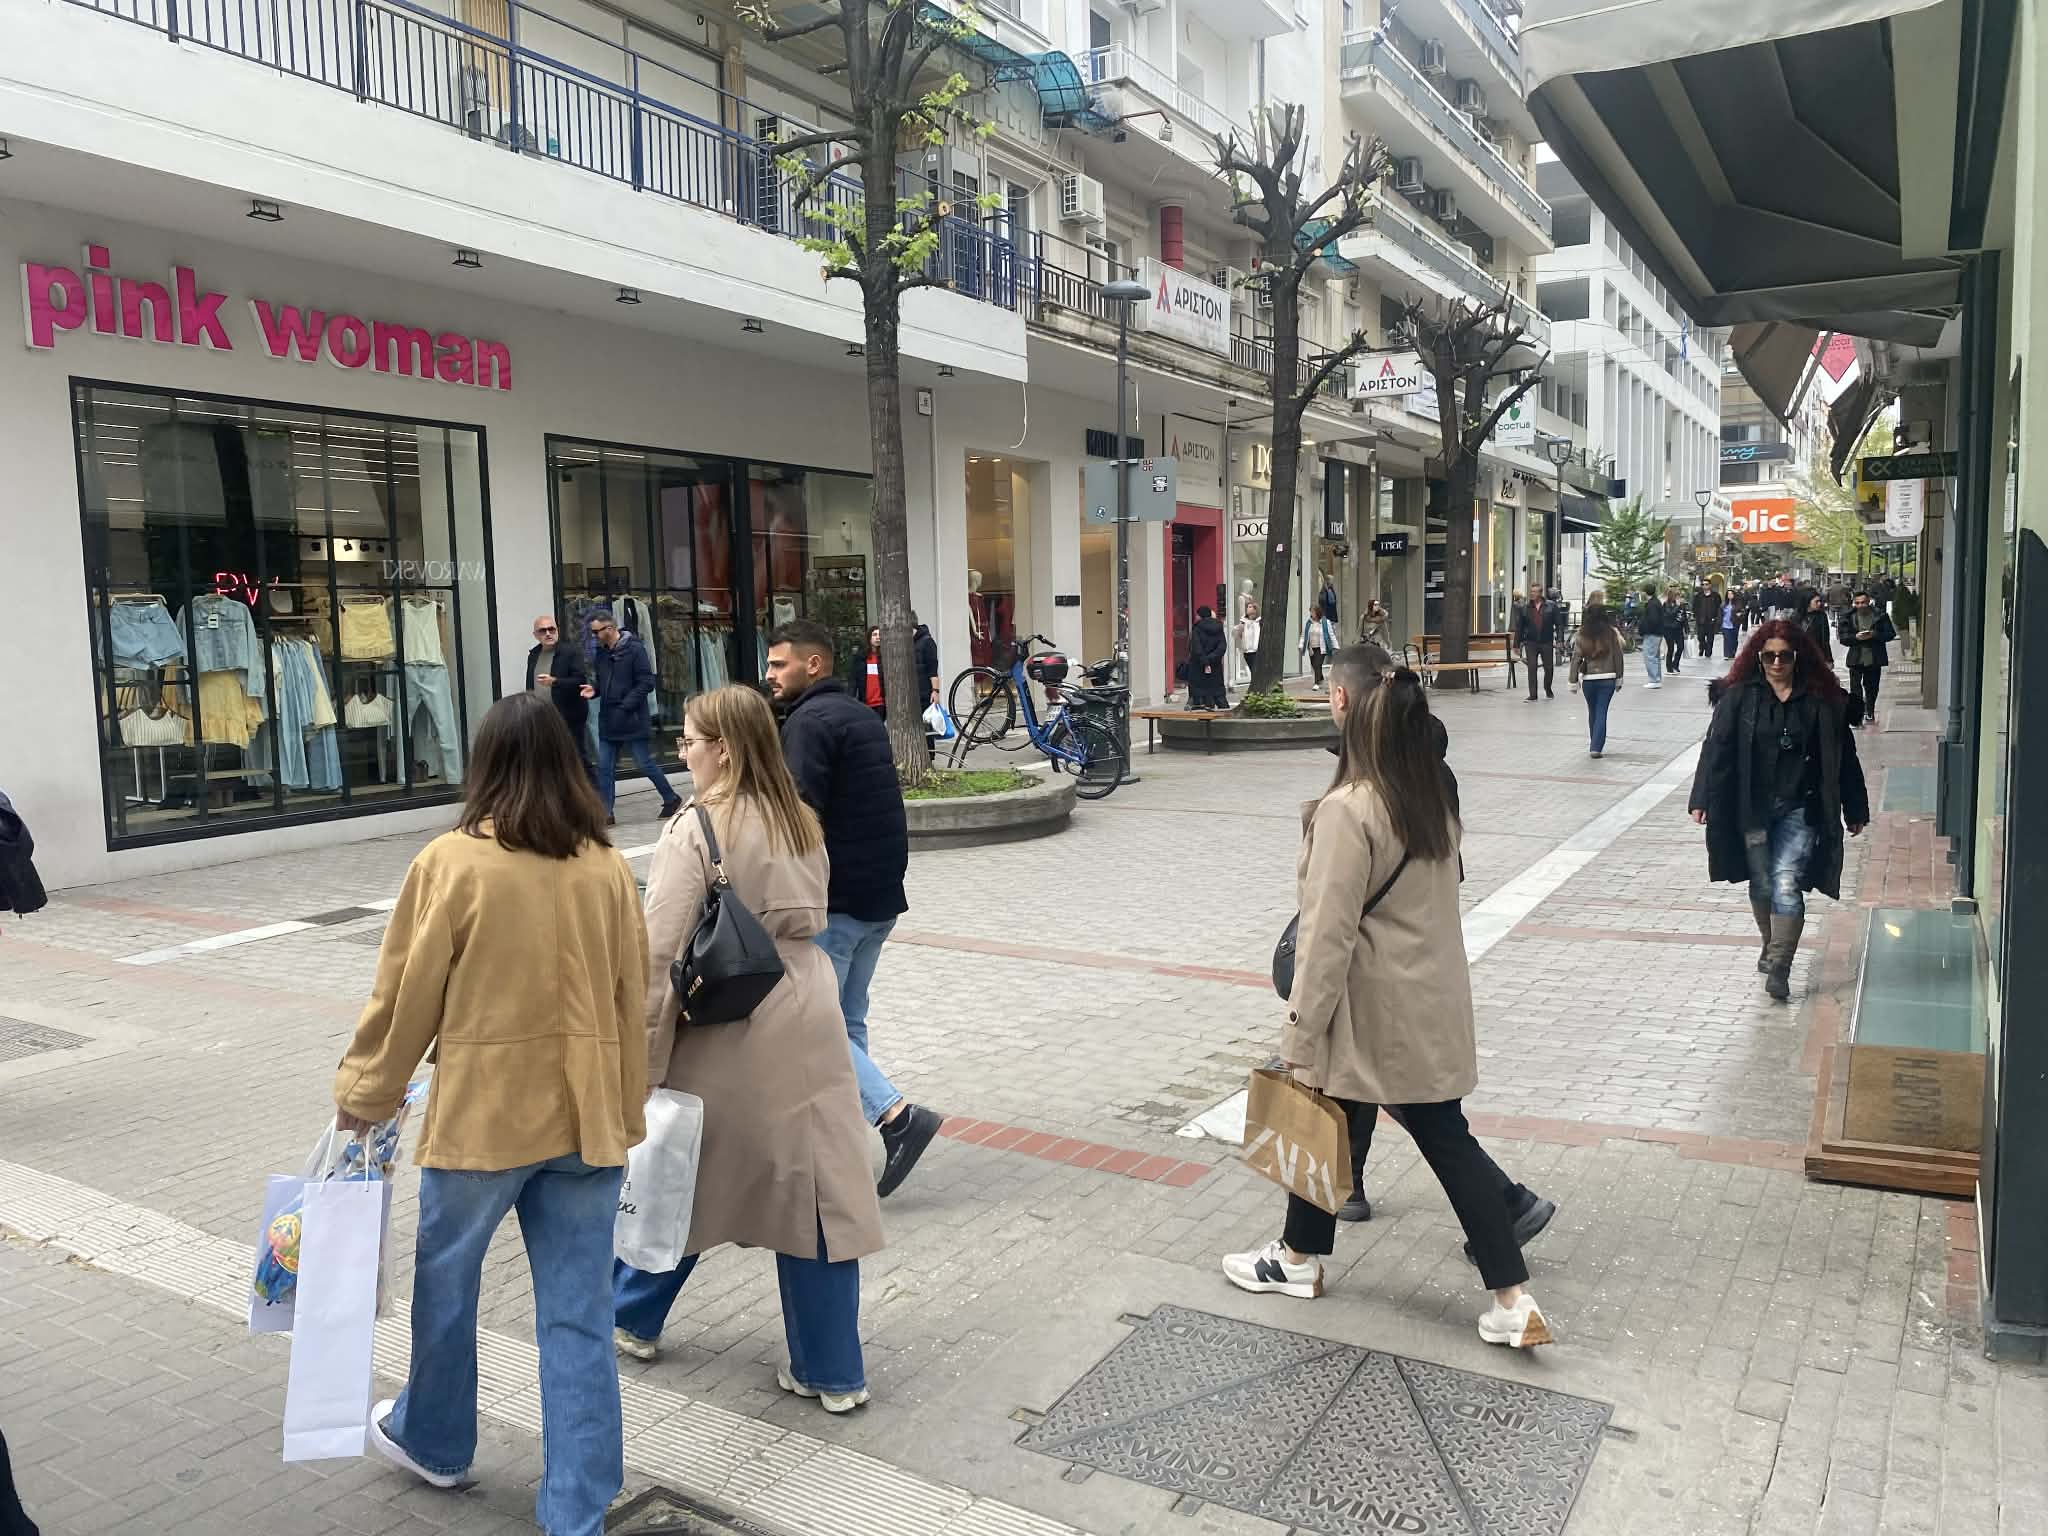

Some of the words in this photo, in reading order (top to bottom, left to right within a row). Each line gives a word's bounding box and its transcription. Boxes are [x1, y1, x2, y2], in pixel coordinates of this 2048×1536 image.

[21, 244, 233, 351] pink
[249, 299, 512, 391] woman
[1358, 375, 1417, 393] ΑΡΙΣΤΟΝ
[1129, 1439, 1237, 1481] WIND
[1308, 1487, 1428, 1535] WIND
